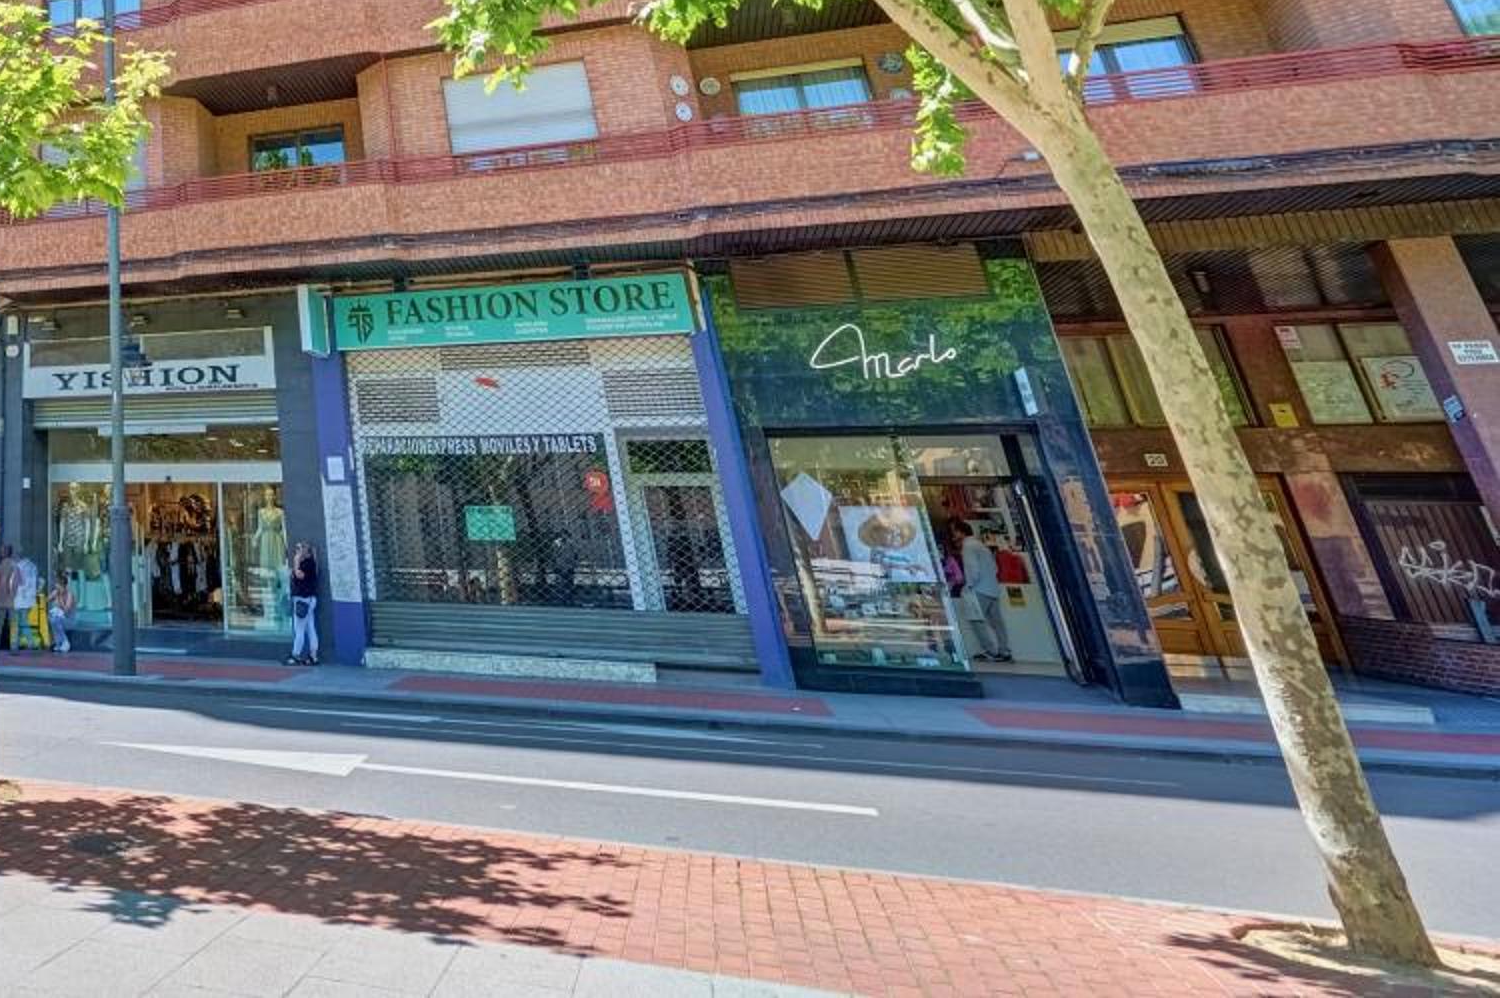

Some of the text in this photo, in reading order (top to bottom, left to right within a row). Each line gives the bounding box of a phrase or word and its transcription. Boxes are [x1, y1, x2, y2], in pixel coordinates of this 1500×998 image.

[385, 281, 675, 325] FASHION STORE
[542, 433, 597, 454] TABLETS
